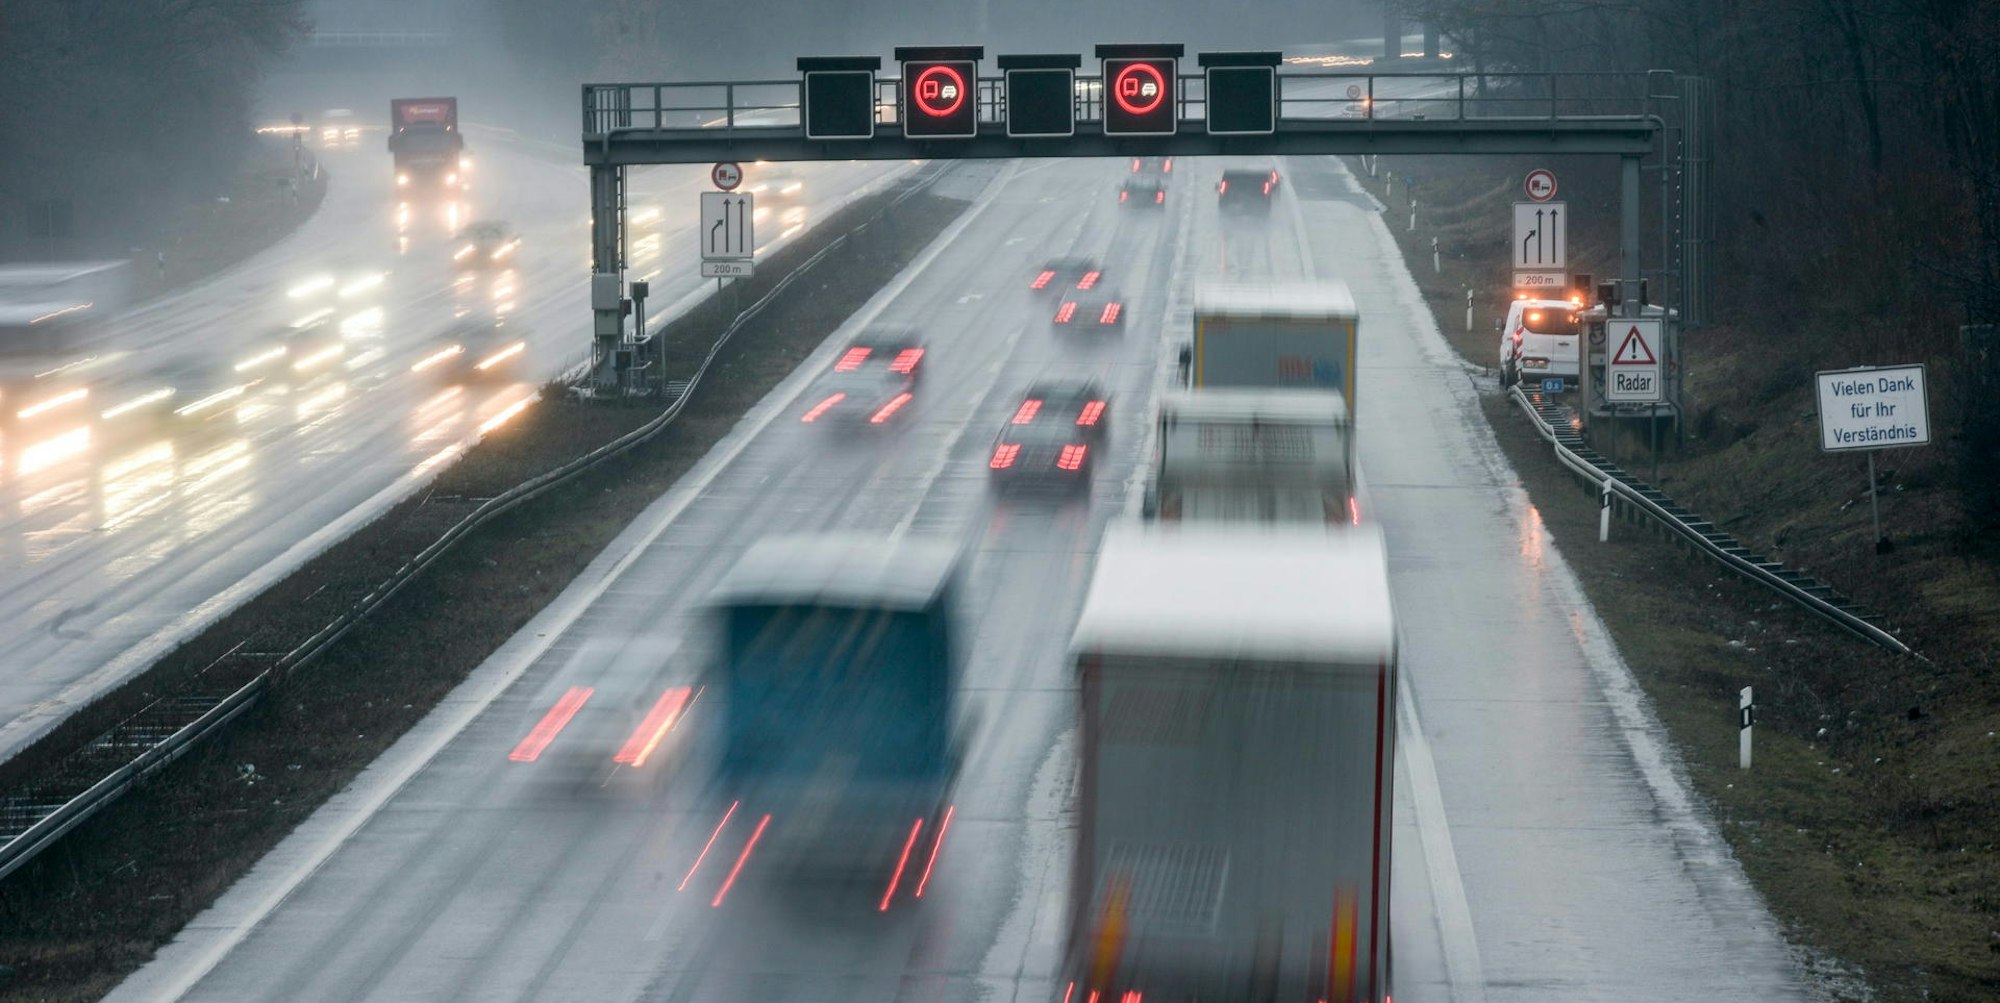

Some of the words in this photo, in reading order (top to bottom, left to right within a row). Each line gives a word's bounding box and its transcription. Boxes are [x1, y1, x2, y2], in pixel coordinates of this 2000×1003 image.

[714, 264, 730, 274] 200
[1526, 275, 1543, 285] 200
[1545, 277, 1554, 285] m
[1617, 373, 1651, 391] Radar
[1831, 380, 1875, 397] Vielen
[1878, 376, 1915, 393] Dank
[1850, 403, 1871, 418] für
[1876, 401, 1896, 416] Ihr
[1833, 424, 1917, 443] Verständnis
